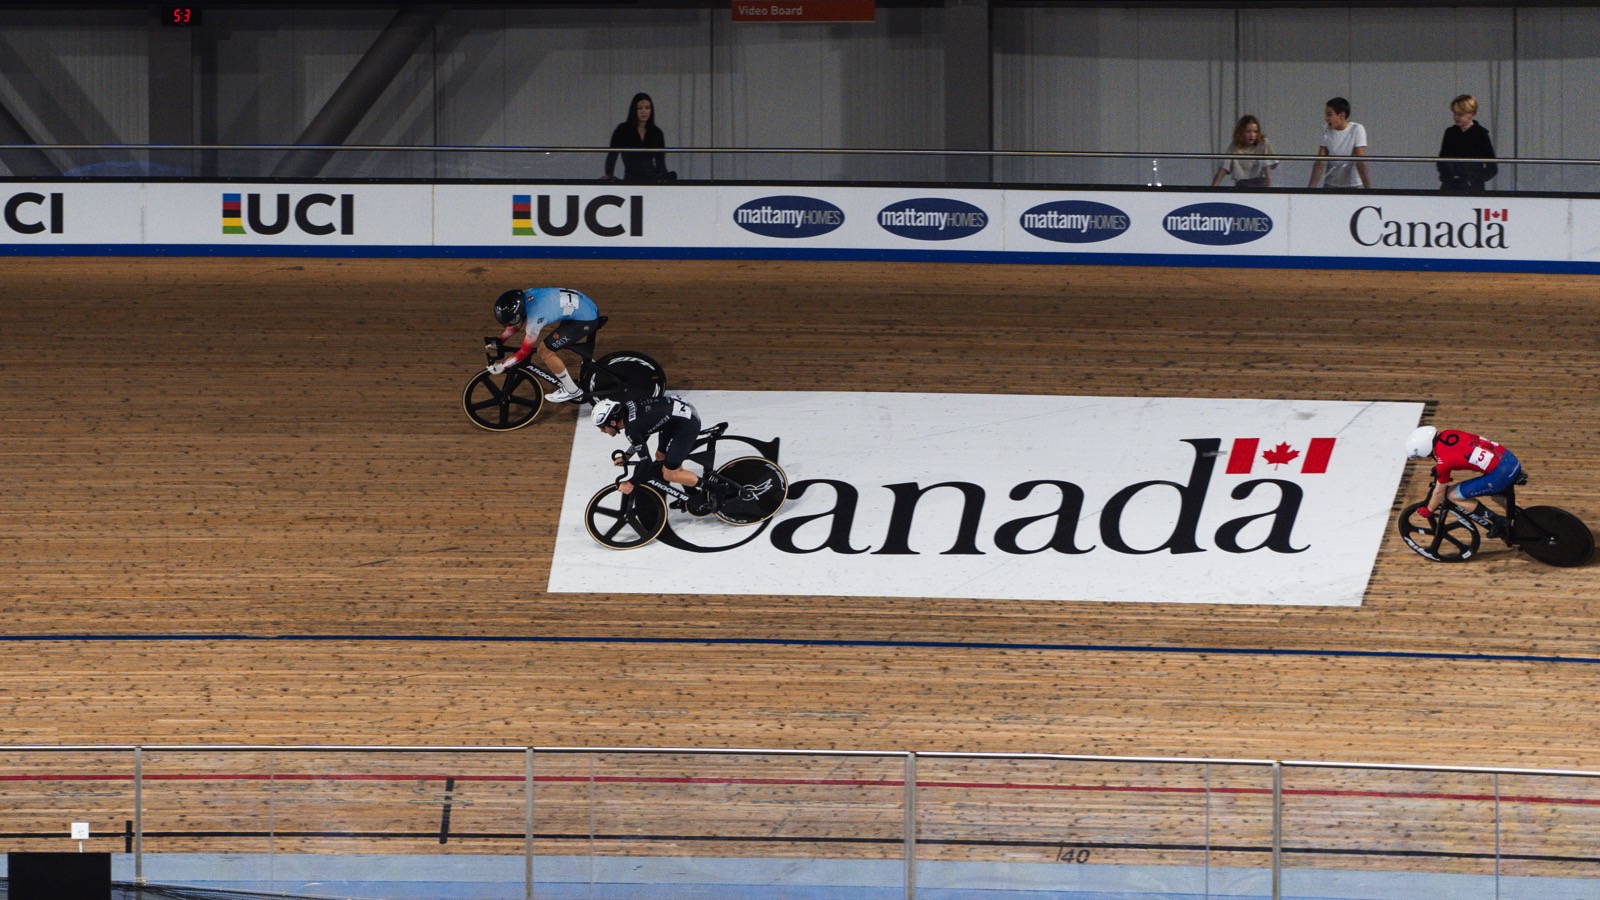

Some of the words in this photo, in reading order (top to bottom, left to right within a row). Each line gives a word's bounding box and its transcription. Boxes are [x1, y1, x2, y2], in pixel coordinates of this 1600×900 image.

[738, 5, 768, 15] Video
[770, 5, 803, 15] Board
[247, 193, 354, 235] UCI
[537, 195, 643, 237] UCI
[1350, 205, 1509, 249] Canada
[551, 335, 571, 349] BRIX
[526, 365, 558, 383] ARGON
[1477, 450, 1487, 462] 5
[647, 479, 679, 497] ARGON
